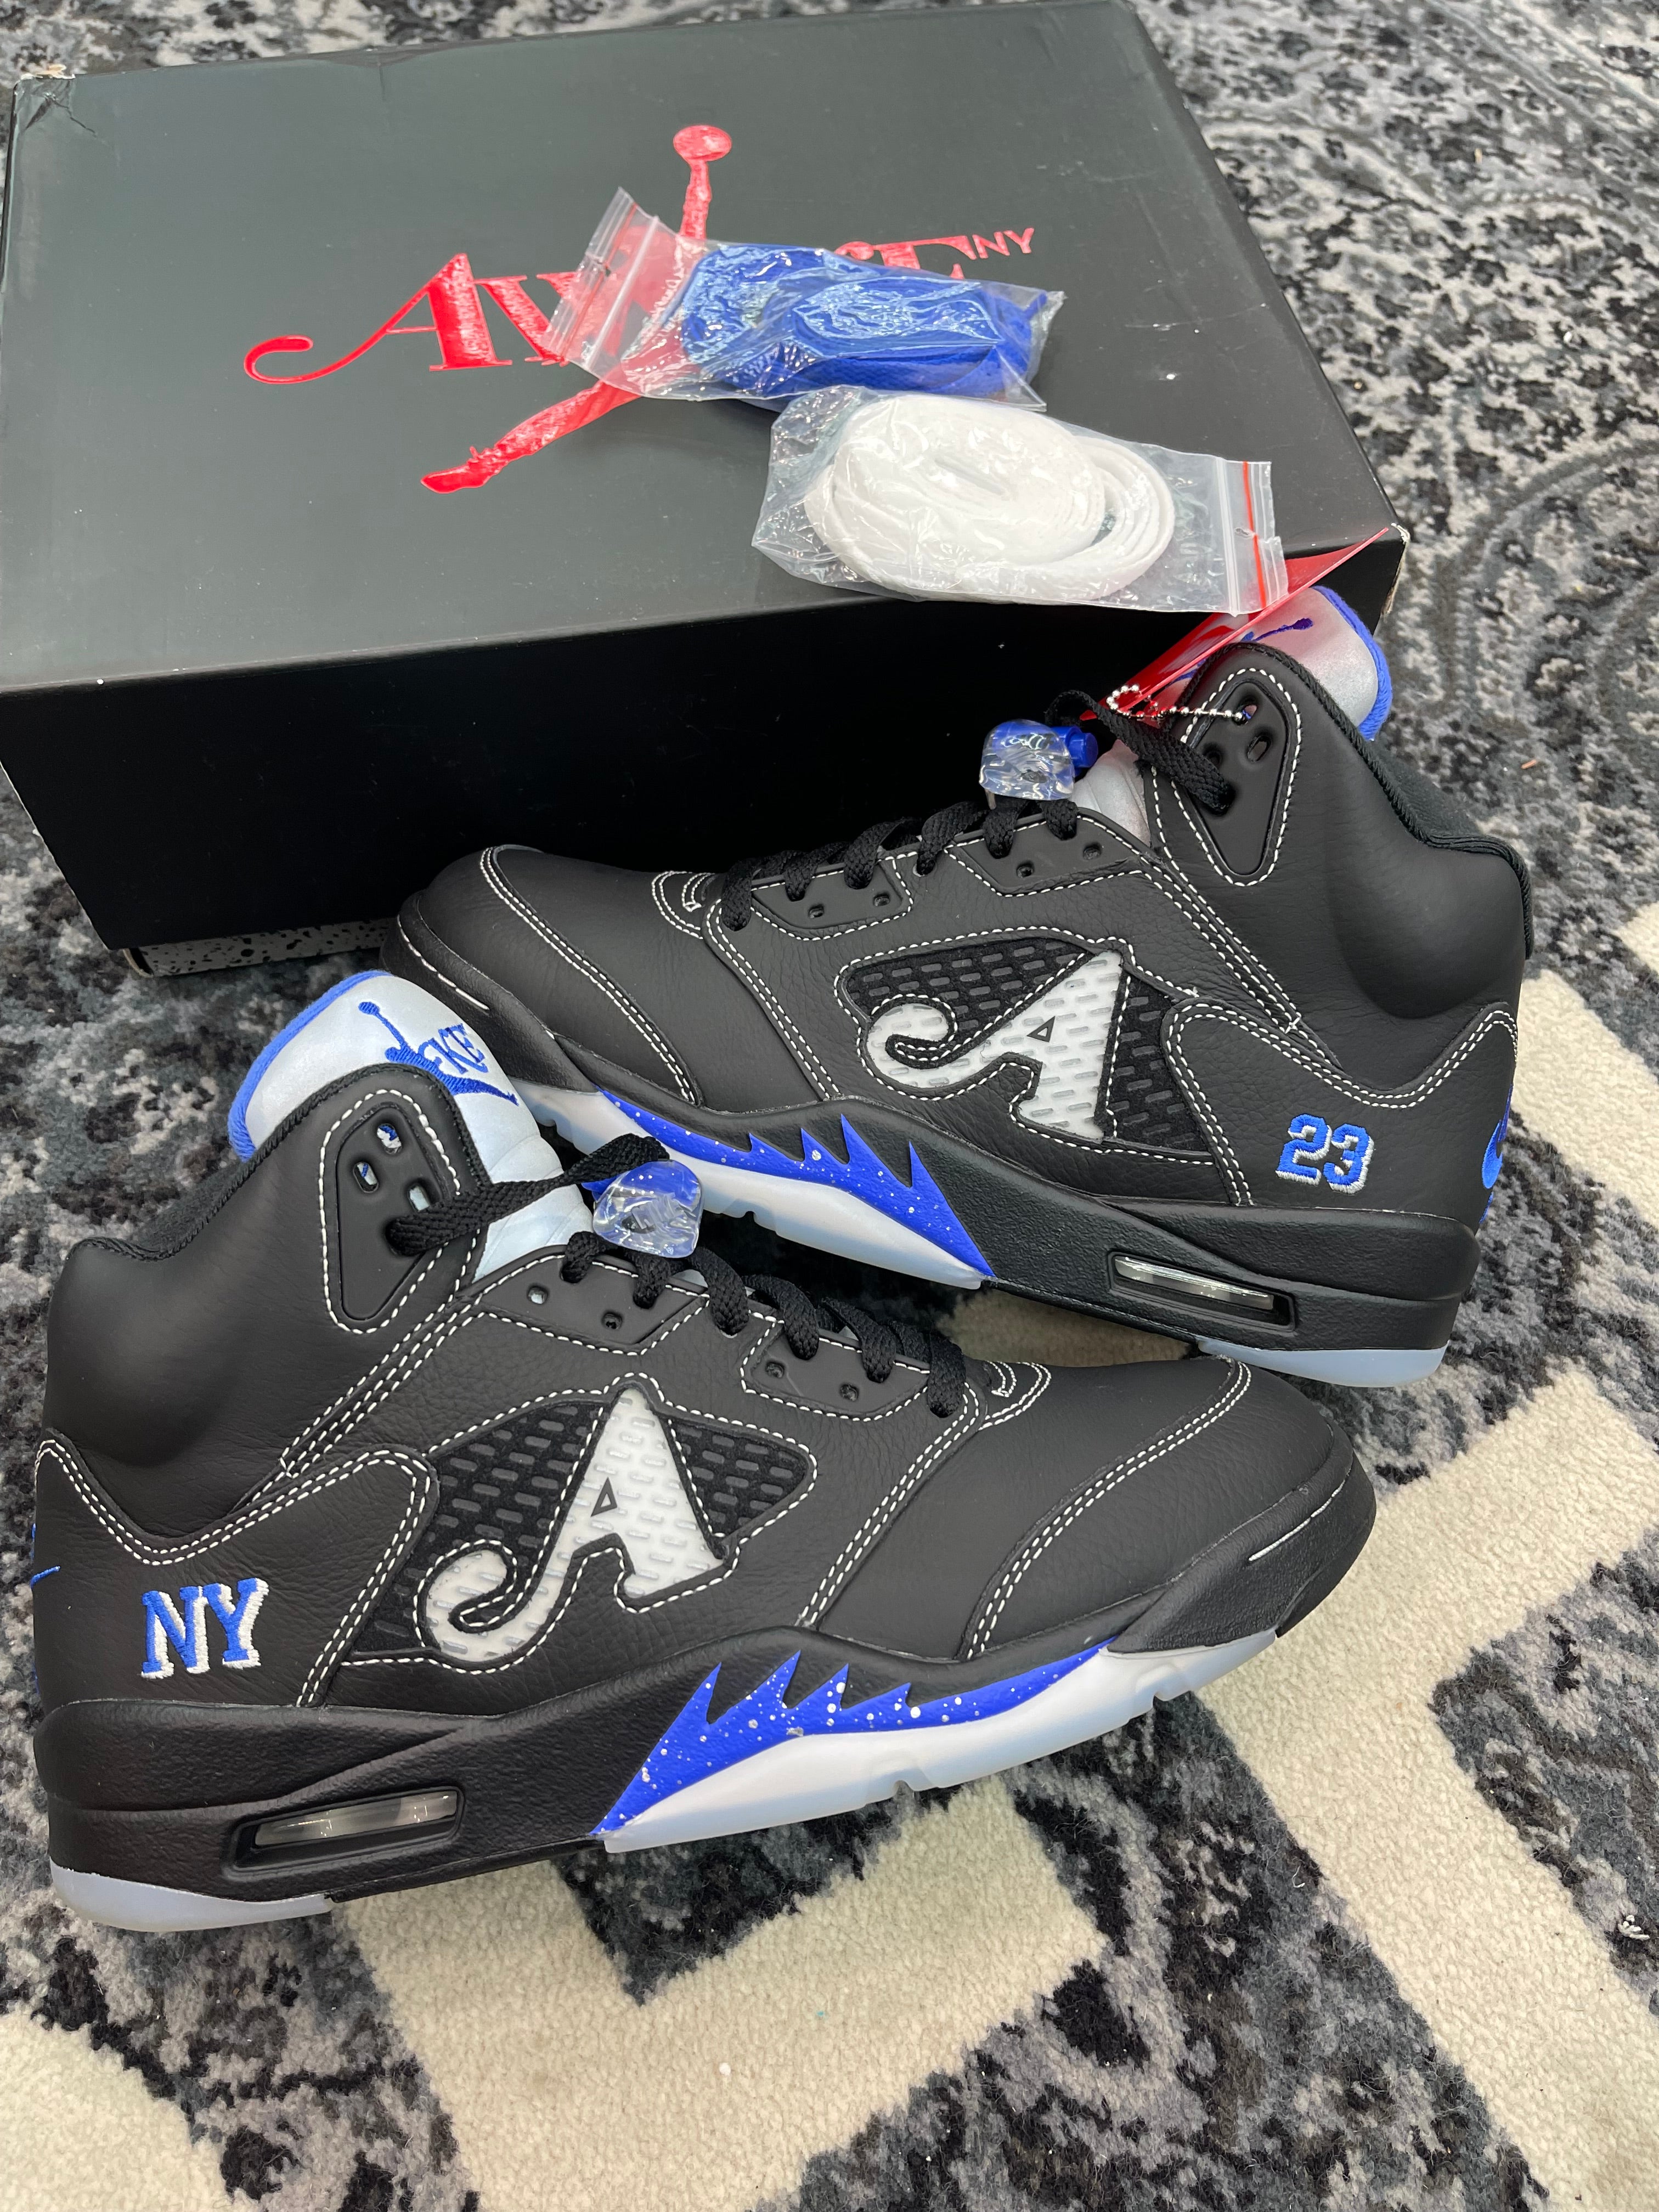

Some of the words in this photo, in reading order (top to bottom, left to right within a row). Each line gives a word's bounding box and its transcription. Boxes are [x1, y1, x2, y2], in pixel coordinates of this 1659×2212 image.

[972, 227, 1035, 259] NY
[1275, 1114, 1374, 1195] 23
[141, 1577, 269, 1679] NY
